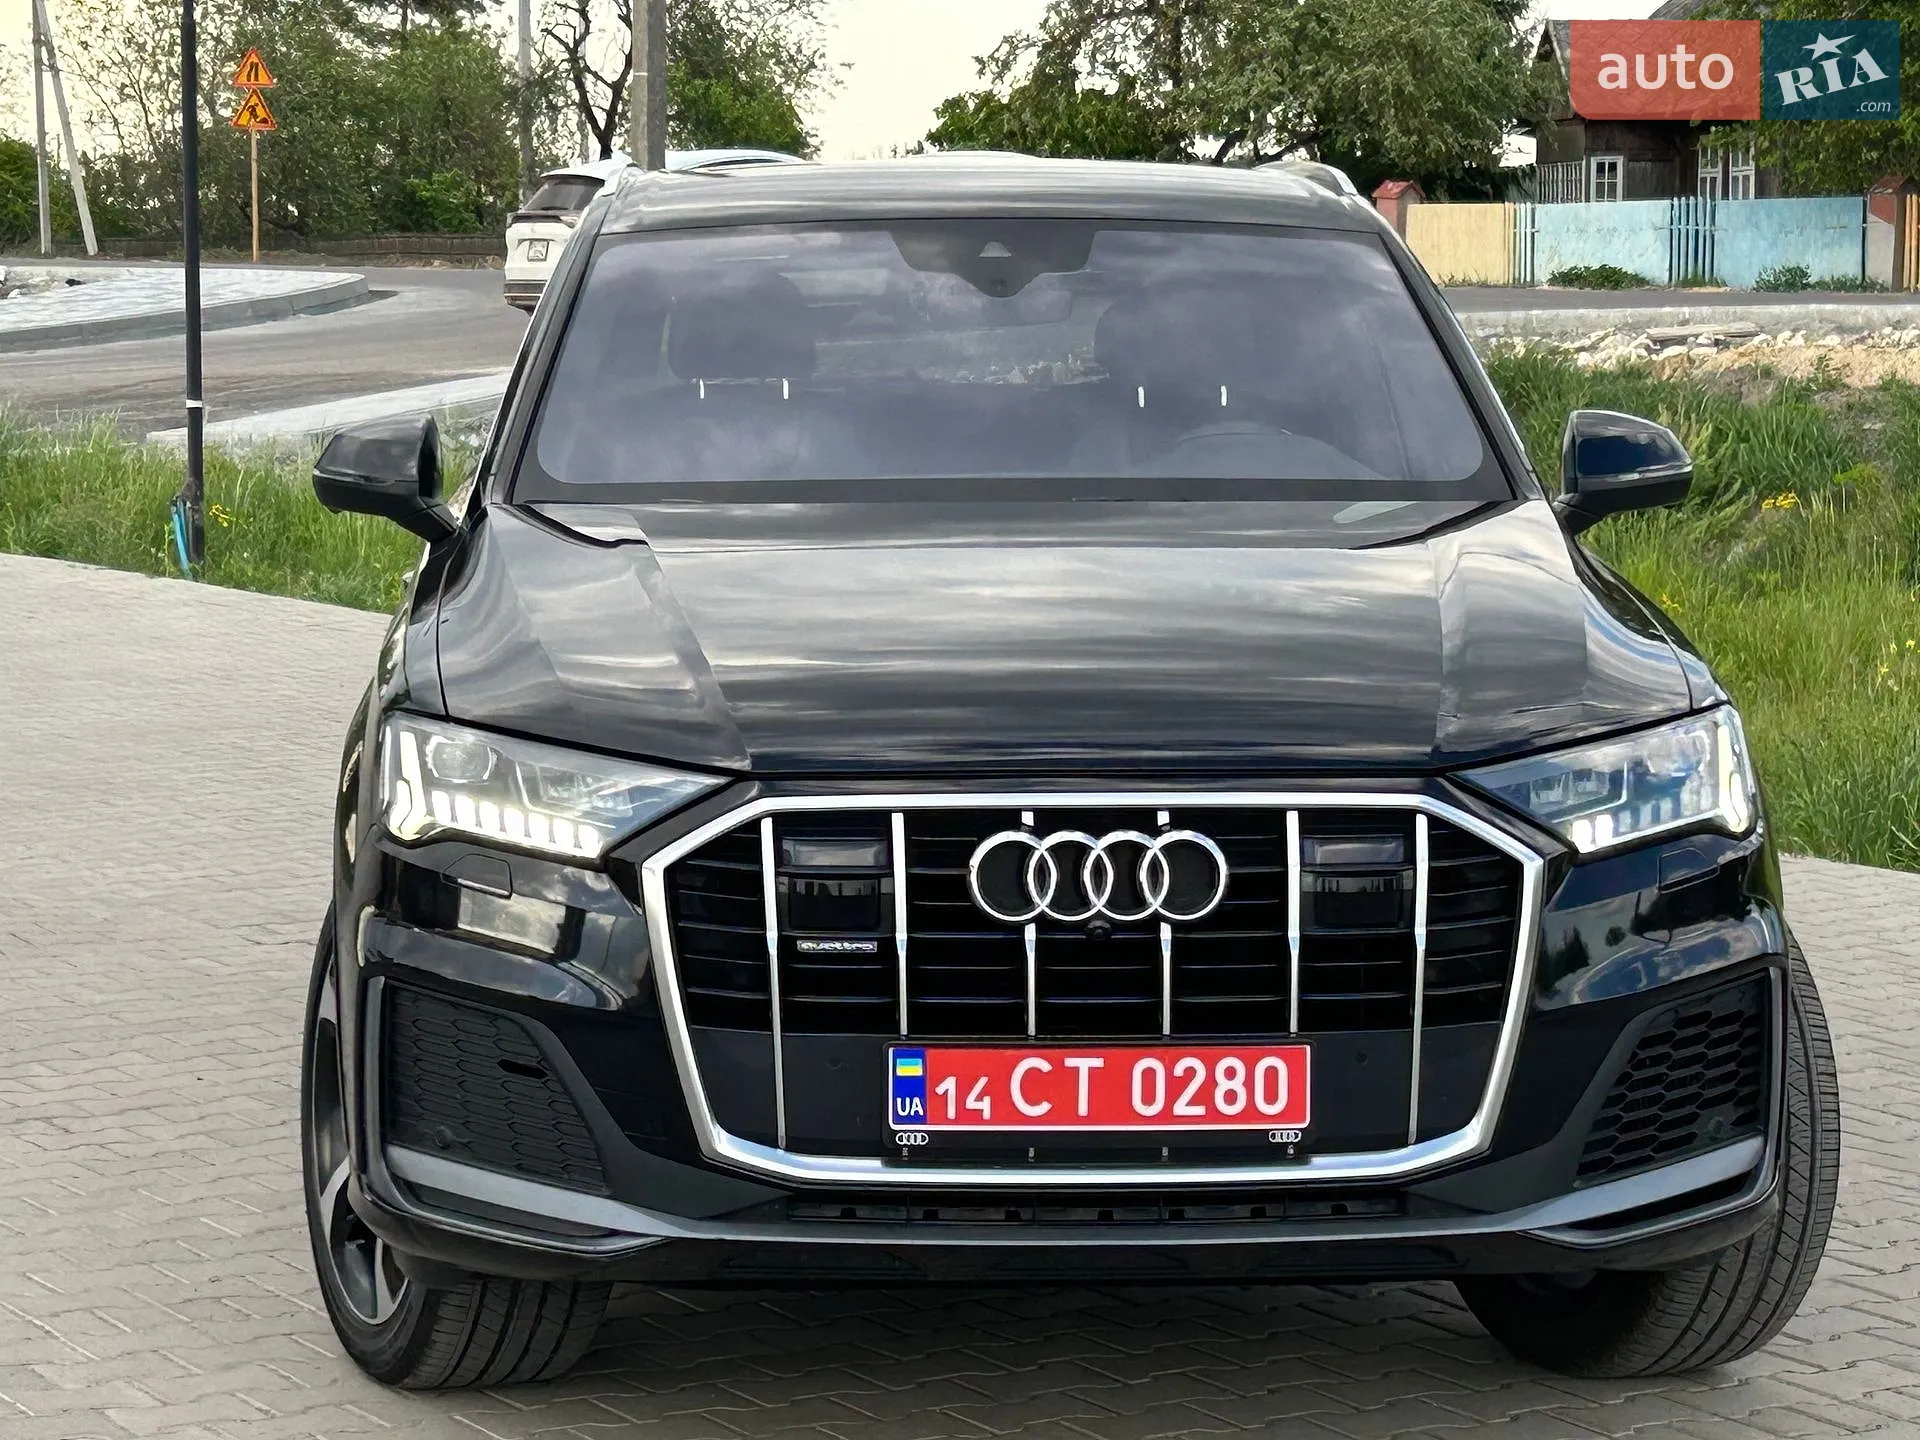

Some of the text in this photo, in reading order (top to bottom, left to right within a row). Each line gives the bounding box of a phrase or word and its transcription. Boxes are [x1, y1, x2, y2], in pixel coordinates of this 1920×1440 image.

[896, 1097, 924, 1117] UA
[934, 1056, 1289, 1120] 14 CT 0280
